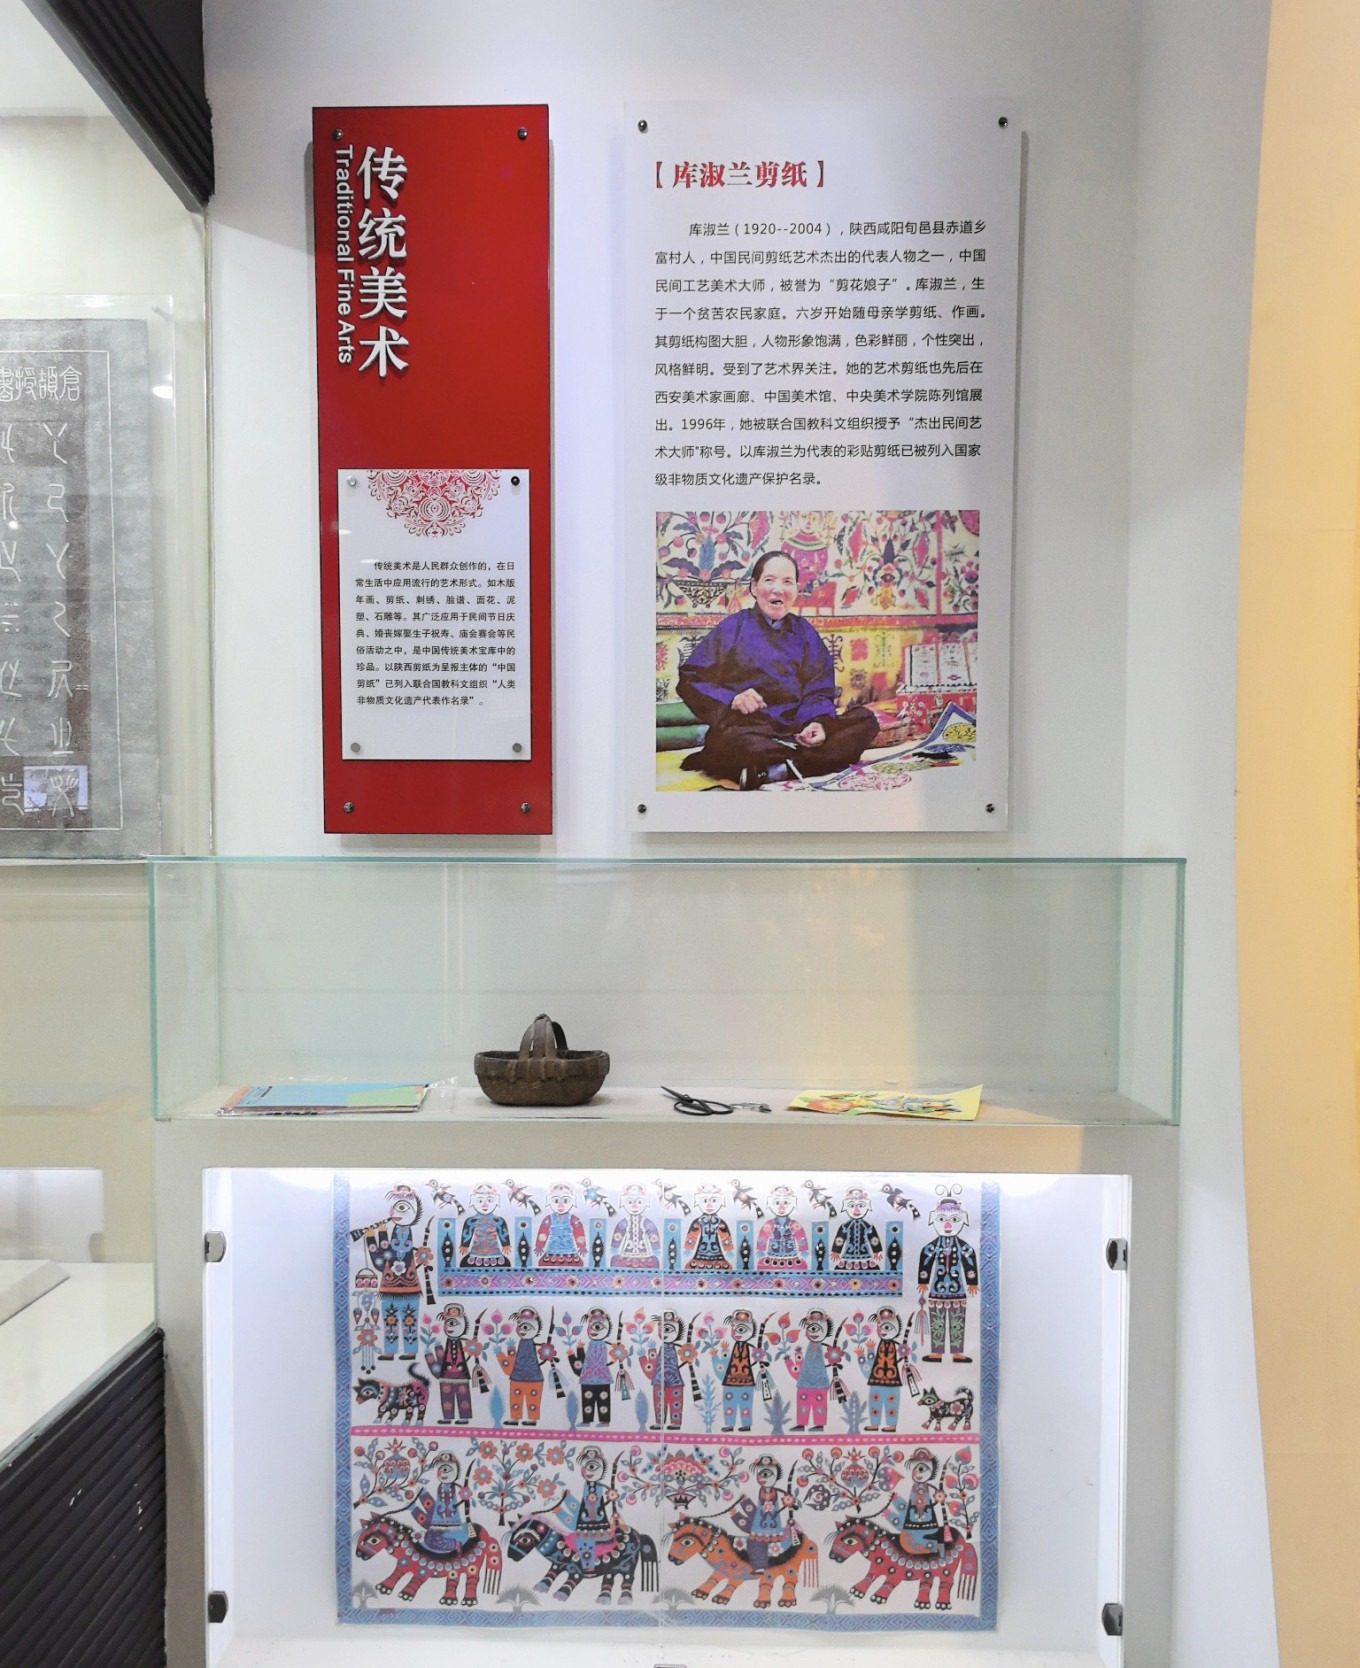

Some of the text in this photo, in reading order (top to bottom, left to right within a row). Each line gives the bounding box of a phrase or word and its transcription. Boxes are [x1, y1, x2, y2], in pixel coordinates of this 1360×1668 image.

[336, 145, 355, 364] Traditional Fine Arts
[357, 146, 409, 378] 传统美术
[655, 248, 986, 265] 富村人，中国民间剪纸艺术杰出的代表人物之一，中国
[655, 304, 986, 321] 于一个贫苦农民家庭。六岁开始随母亲学剪纸、作画。
[655, 332, 984, 349] 其剪纸构图大胆，人物形象饱满，色彩鲜丽，个性突出，
[655, 360, 984, 377] 风格鲜明。受到了艺术界关注。她的艺术剪纸也先后在
[655, 388, 983, 404] 西安美术家画廊、中国美术馆、中央美术学院陈列馆展
[655, 471, 821, 487] 级非物质文化遗产保护名录。
